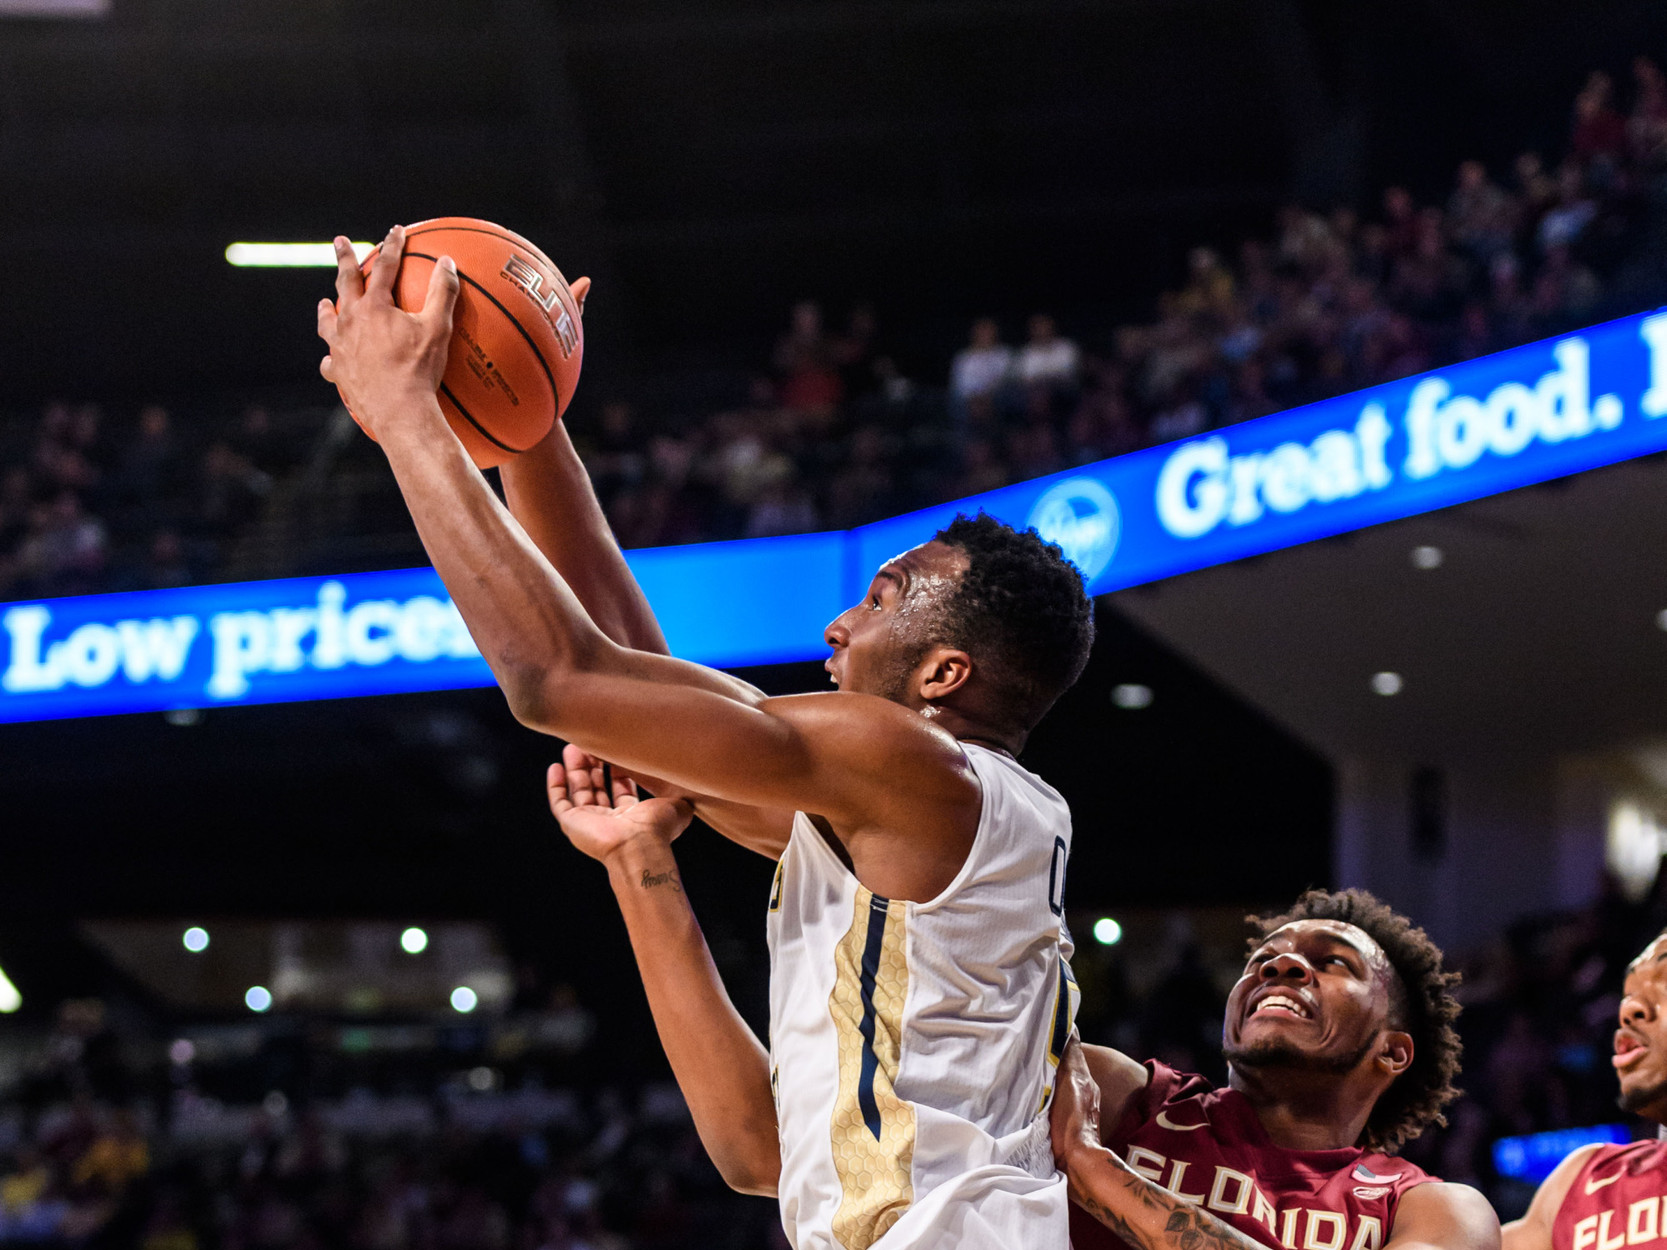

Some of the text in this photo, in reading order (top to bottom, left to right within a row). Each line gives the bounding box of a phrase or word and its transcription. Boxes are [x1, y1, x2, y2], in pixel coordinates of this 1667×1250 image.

[503, 253, 579, 357] ELITE
[1155, 403, 1391, 538] Great
[1405, 335, 1624, 480] food.
[3, 605, 198, 694] Low
